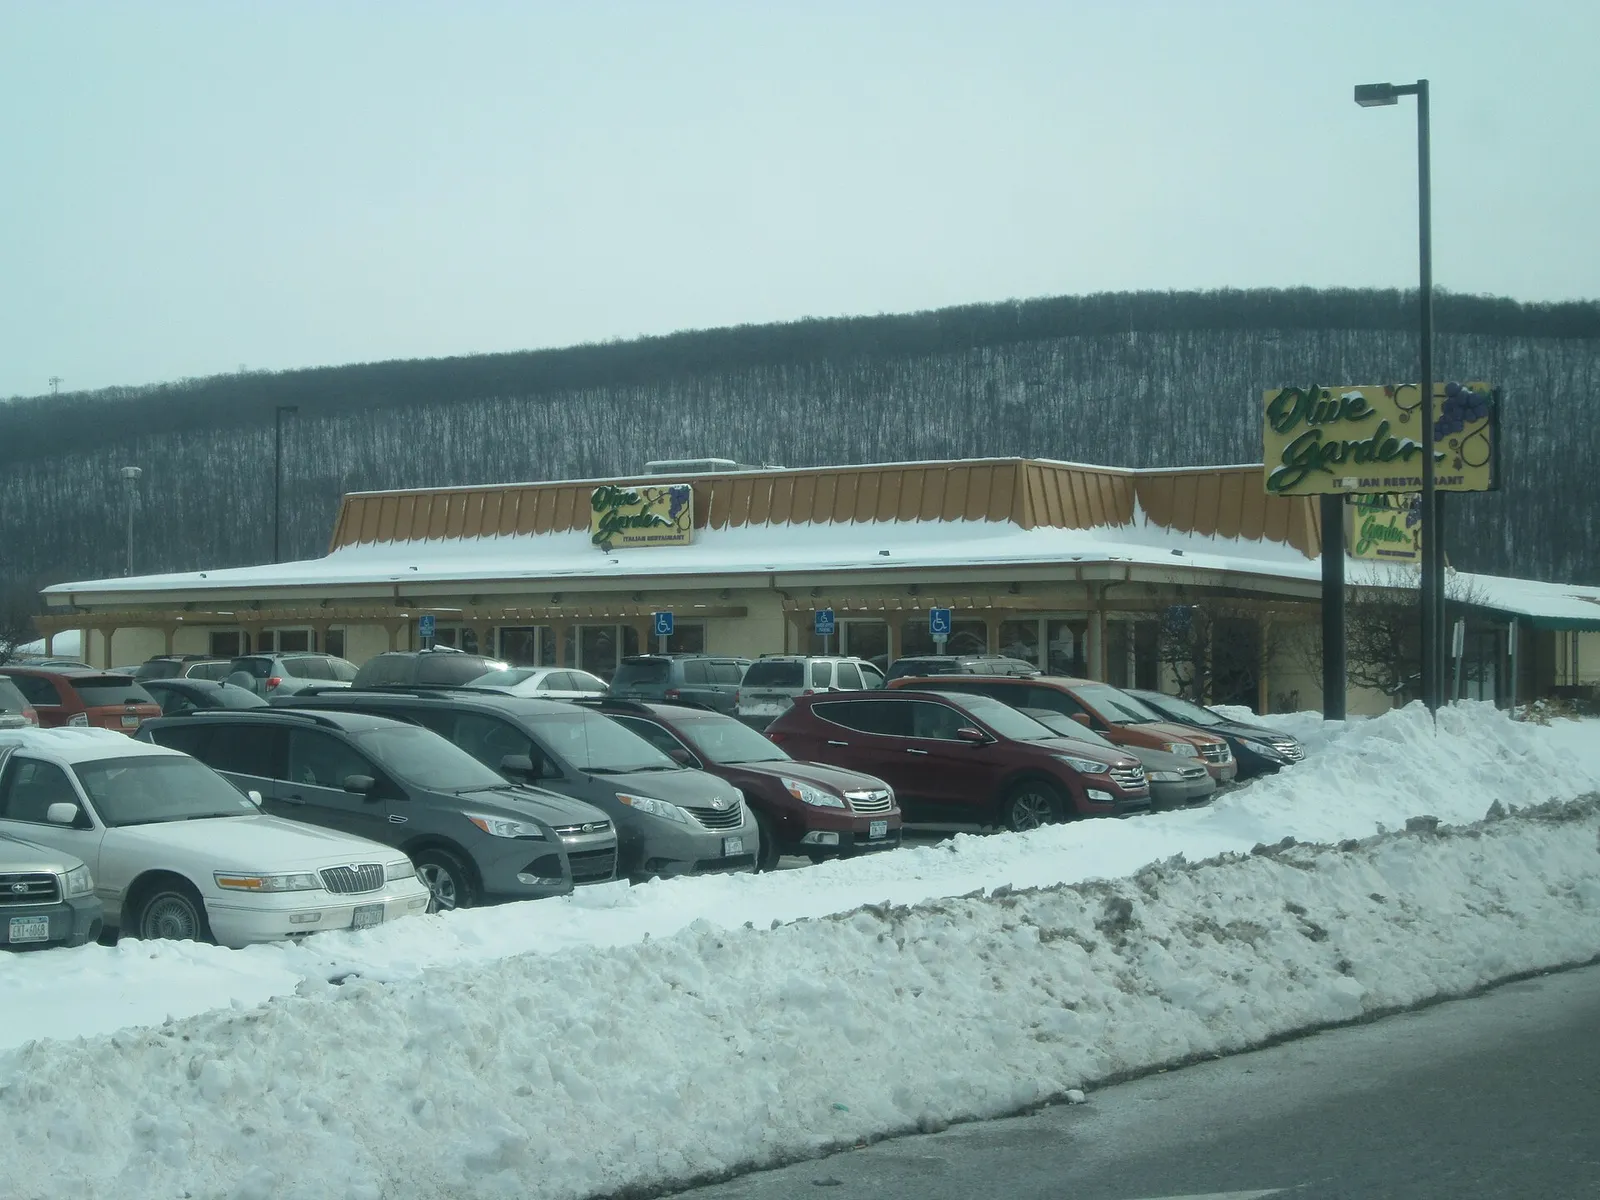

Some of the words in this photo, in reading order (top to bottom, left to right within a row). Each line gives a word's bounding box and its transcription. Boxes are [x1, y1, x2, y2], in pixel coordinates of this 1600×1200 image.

[1266, 383, 1376, 434] Olive
[1266, 418, 1447, 492] Garden
[591, 484, 641, 512] Olive
[1332, 478, 1380, 488] ITIAN
[592, 502, 674, 544] Garden
